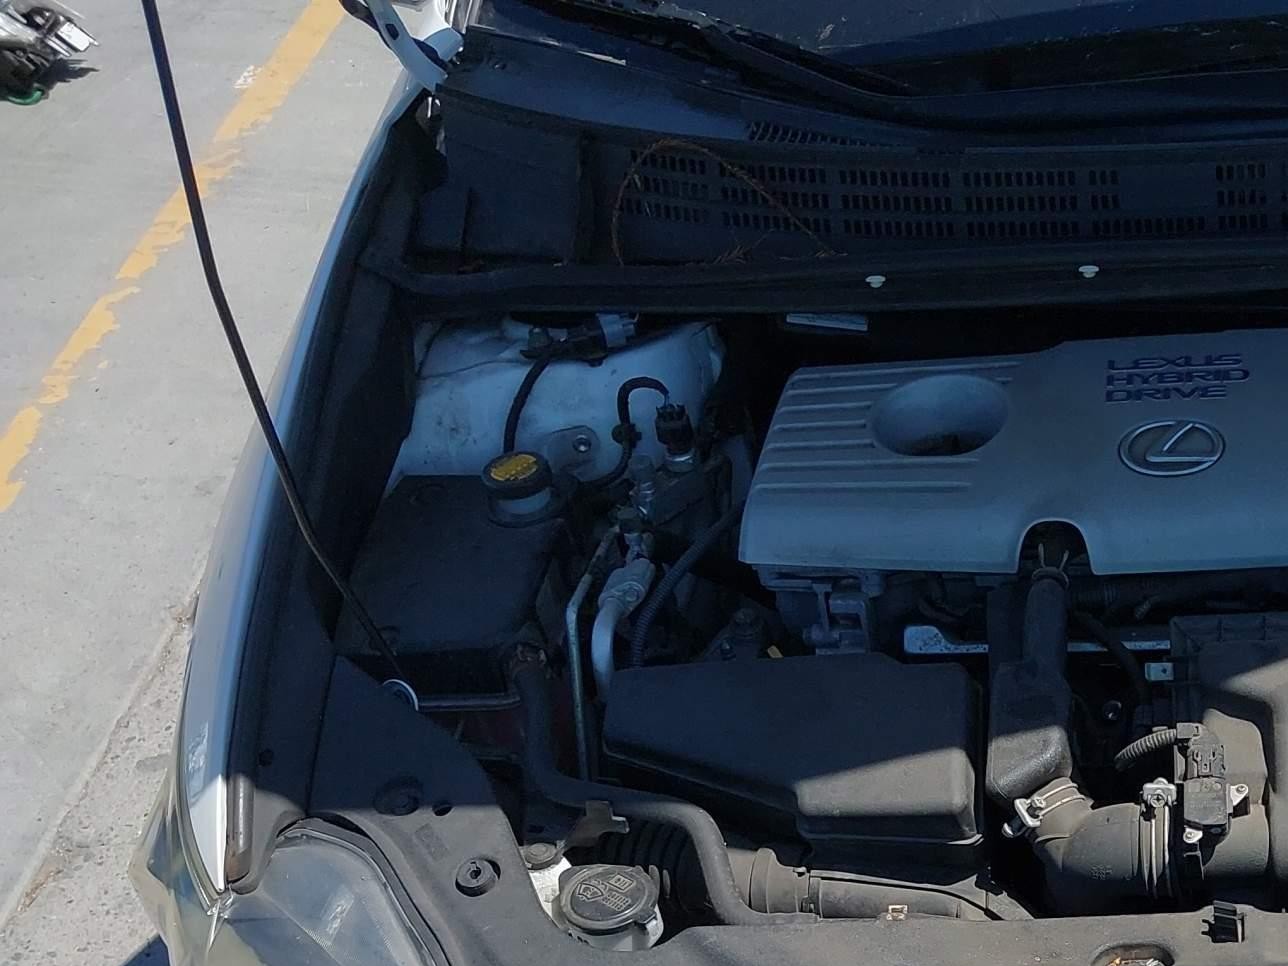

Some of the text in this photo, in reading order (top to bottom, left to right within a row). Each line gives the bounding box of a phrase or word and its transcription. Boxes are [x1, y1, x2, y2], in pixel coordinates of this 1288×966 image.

[1107, 354, 1243, 371] LEXUS
[1106, 369, 1249, 387] HYBRID
[1105, 385, 1228, 402] DRIVE
